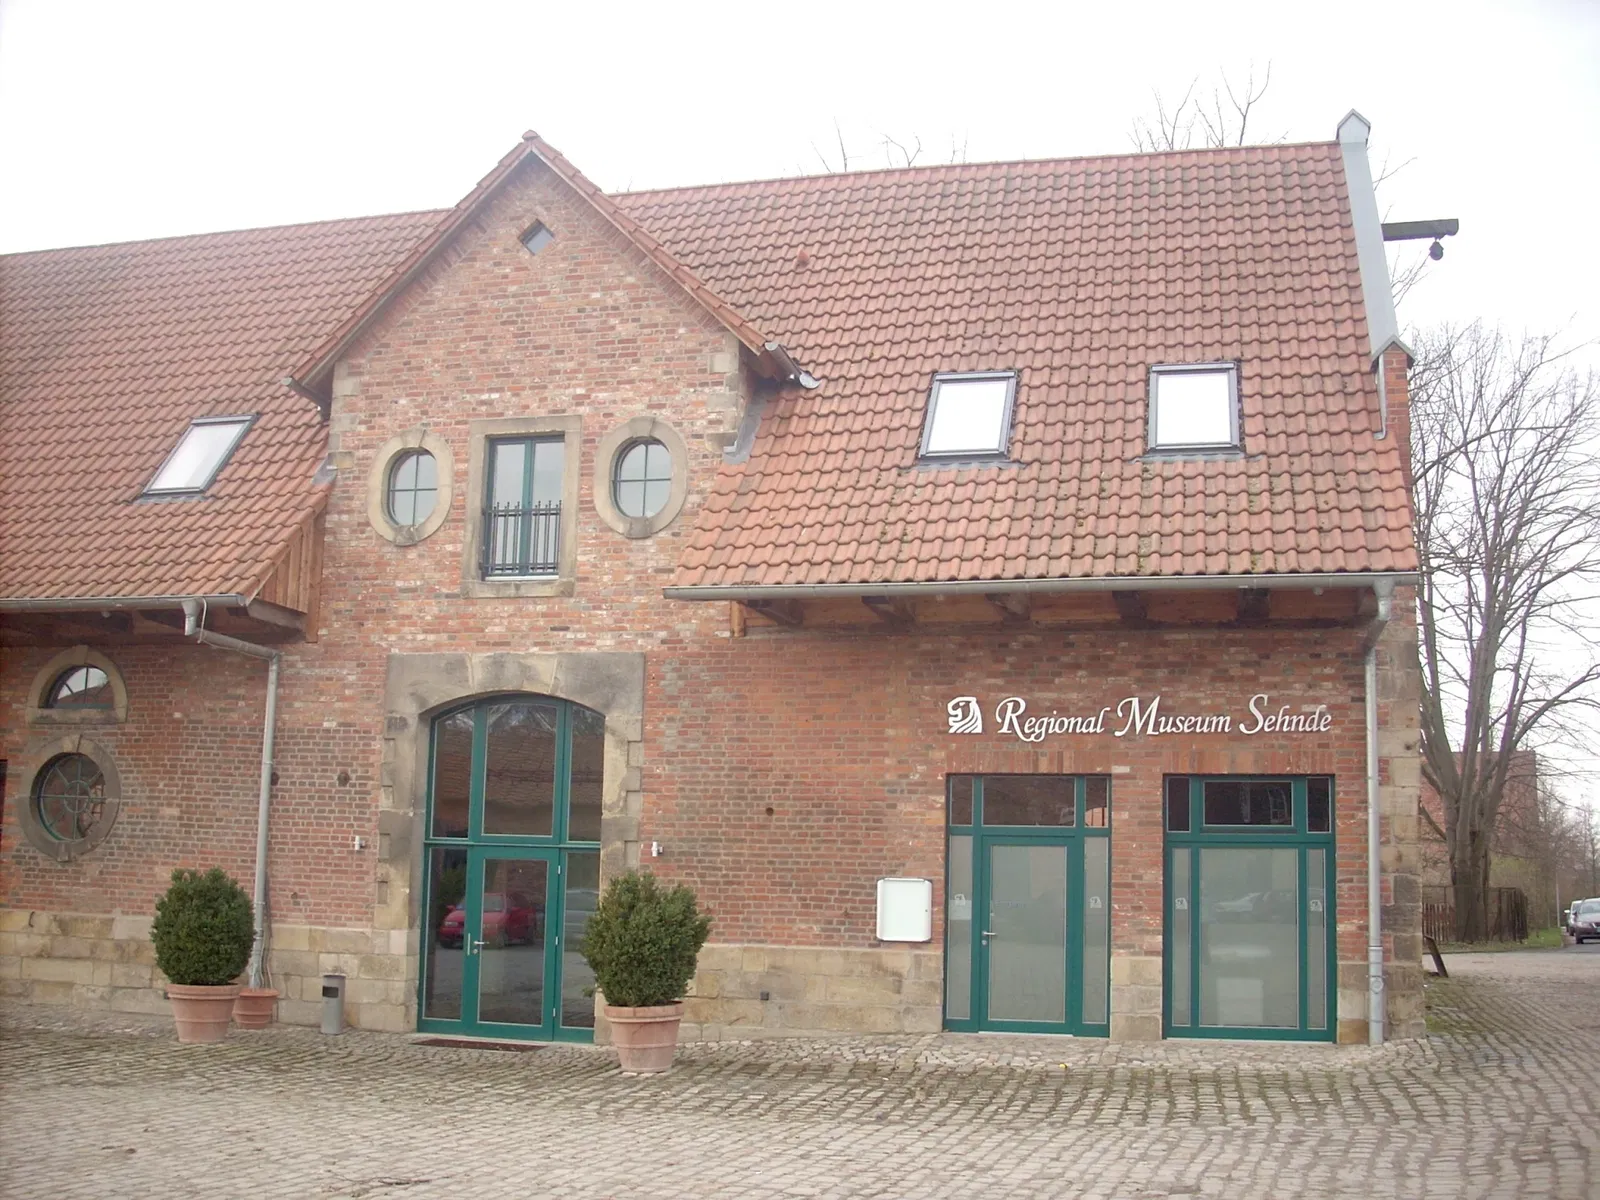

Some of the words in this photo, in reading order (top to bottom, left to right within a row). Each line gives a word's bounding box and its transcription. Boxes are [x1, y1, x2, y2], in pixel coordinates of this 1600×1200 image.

[995, 697, 1110, 742] Regional
[1114, 695, 1232, 736] Museum
[1239, 694, 1332, 735] Sehnde
